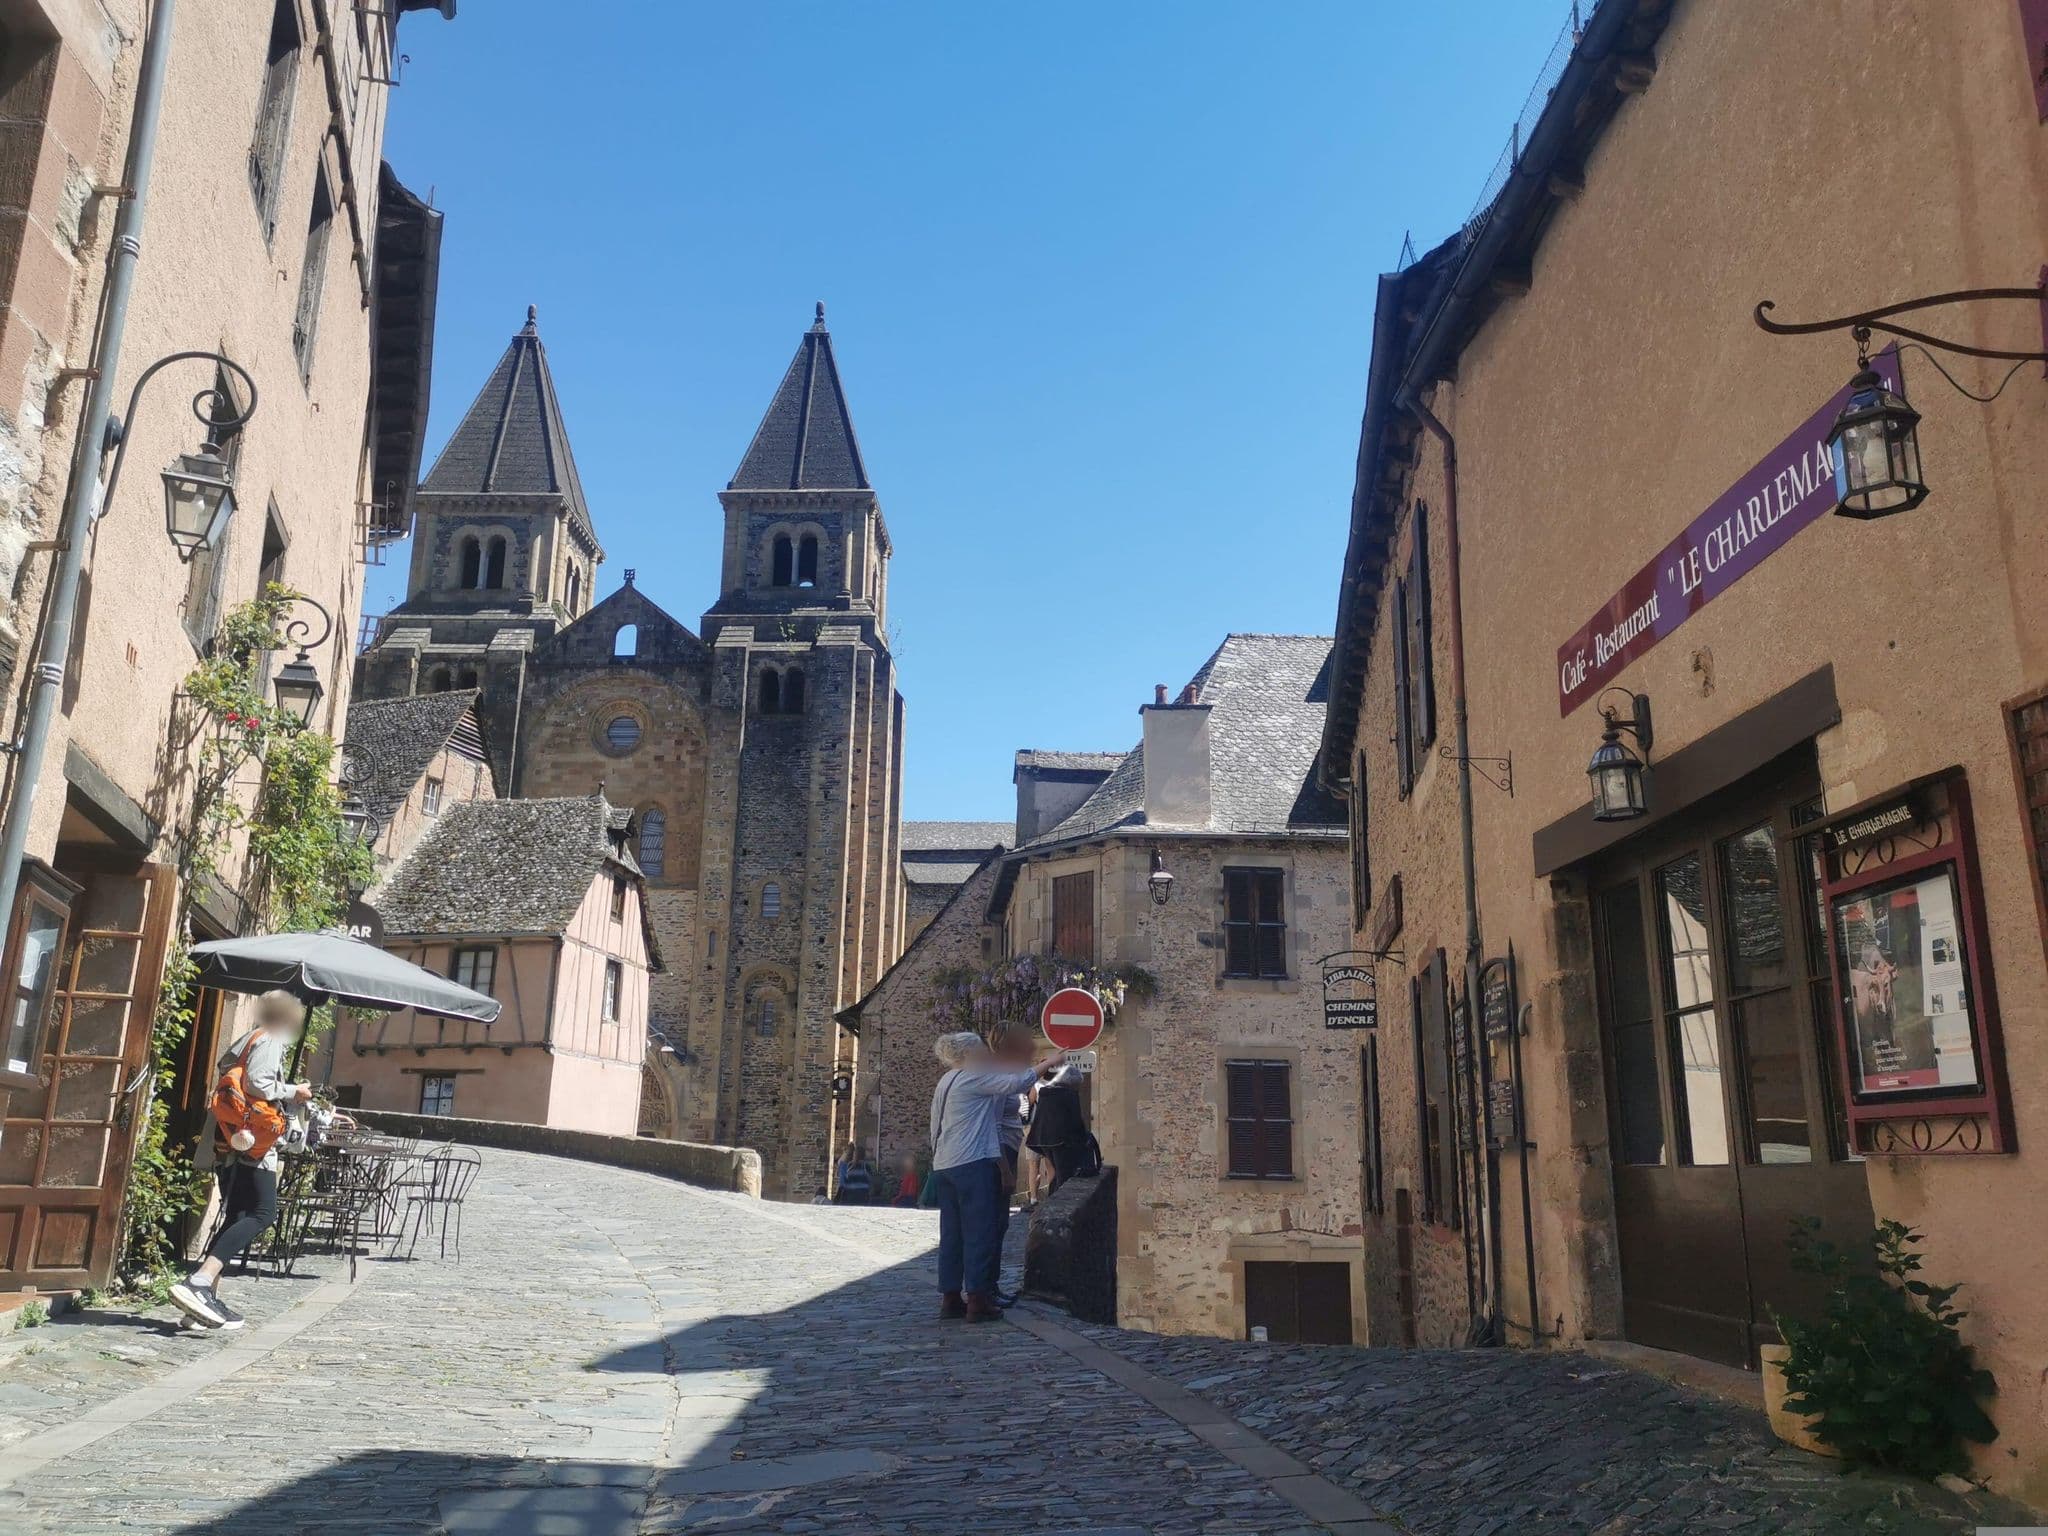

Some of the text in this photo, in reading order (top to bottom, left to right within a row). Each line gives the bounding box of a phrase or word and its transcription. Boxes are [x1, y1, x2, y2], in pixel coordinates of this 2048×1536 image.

[1561, 649, 1587, 695] Café
[1594, 589, 1661, 669] Restaurant
[1833, 829, 1848, 846] LE
[338, 924, 372, 938] BAR
[1323, 969, 1376, 988] LIBRAIRIE
[1326, 1002, 1376, 1012] CHEMINS
[1327, 1015, 1375, 1026] D'ENCRE
